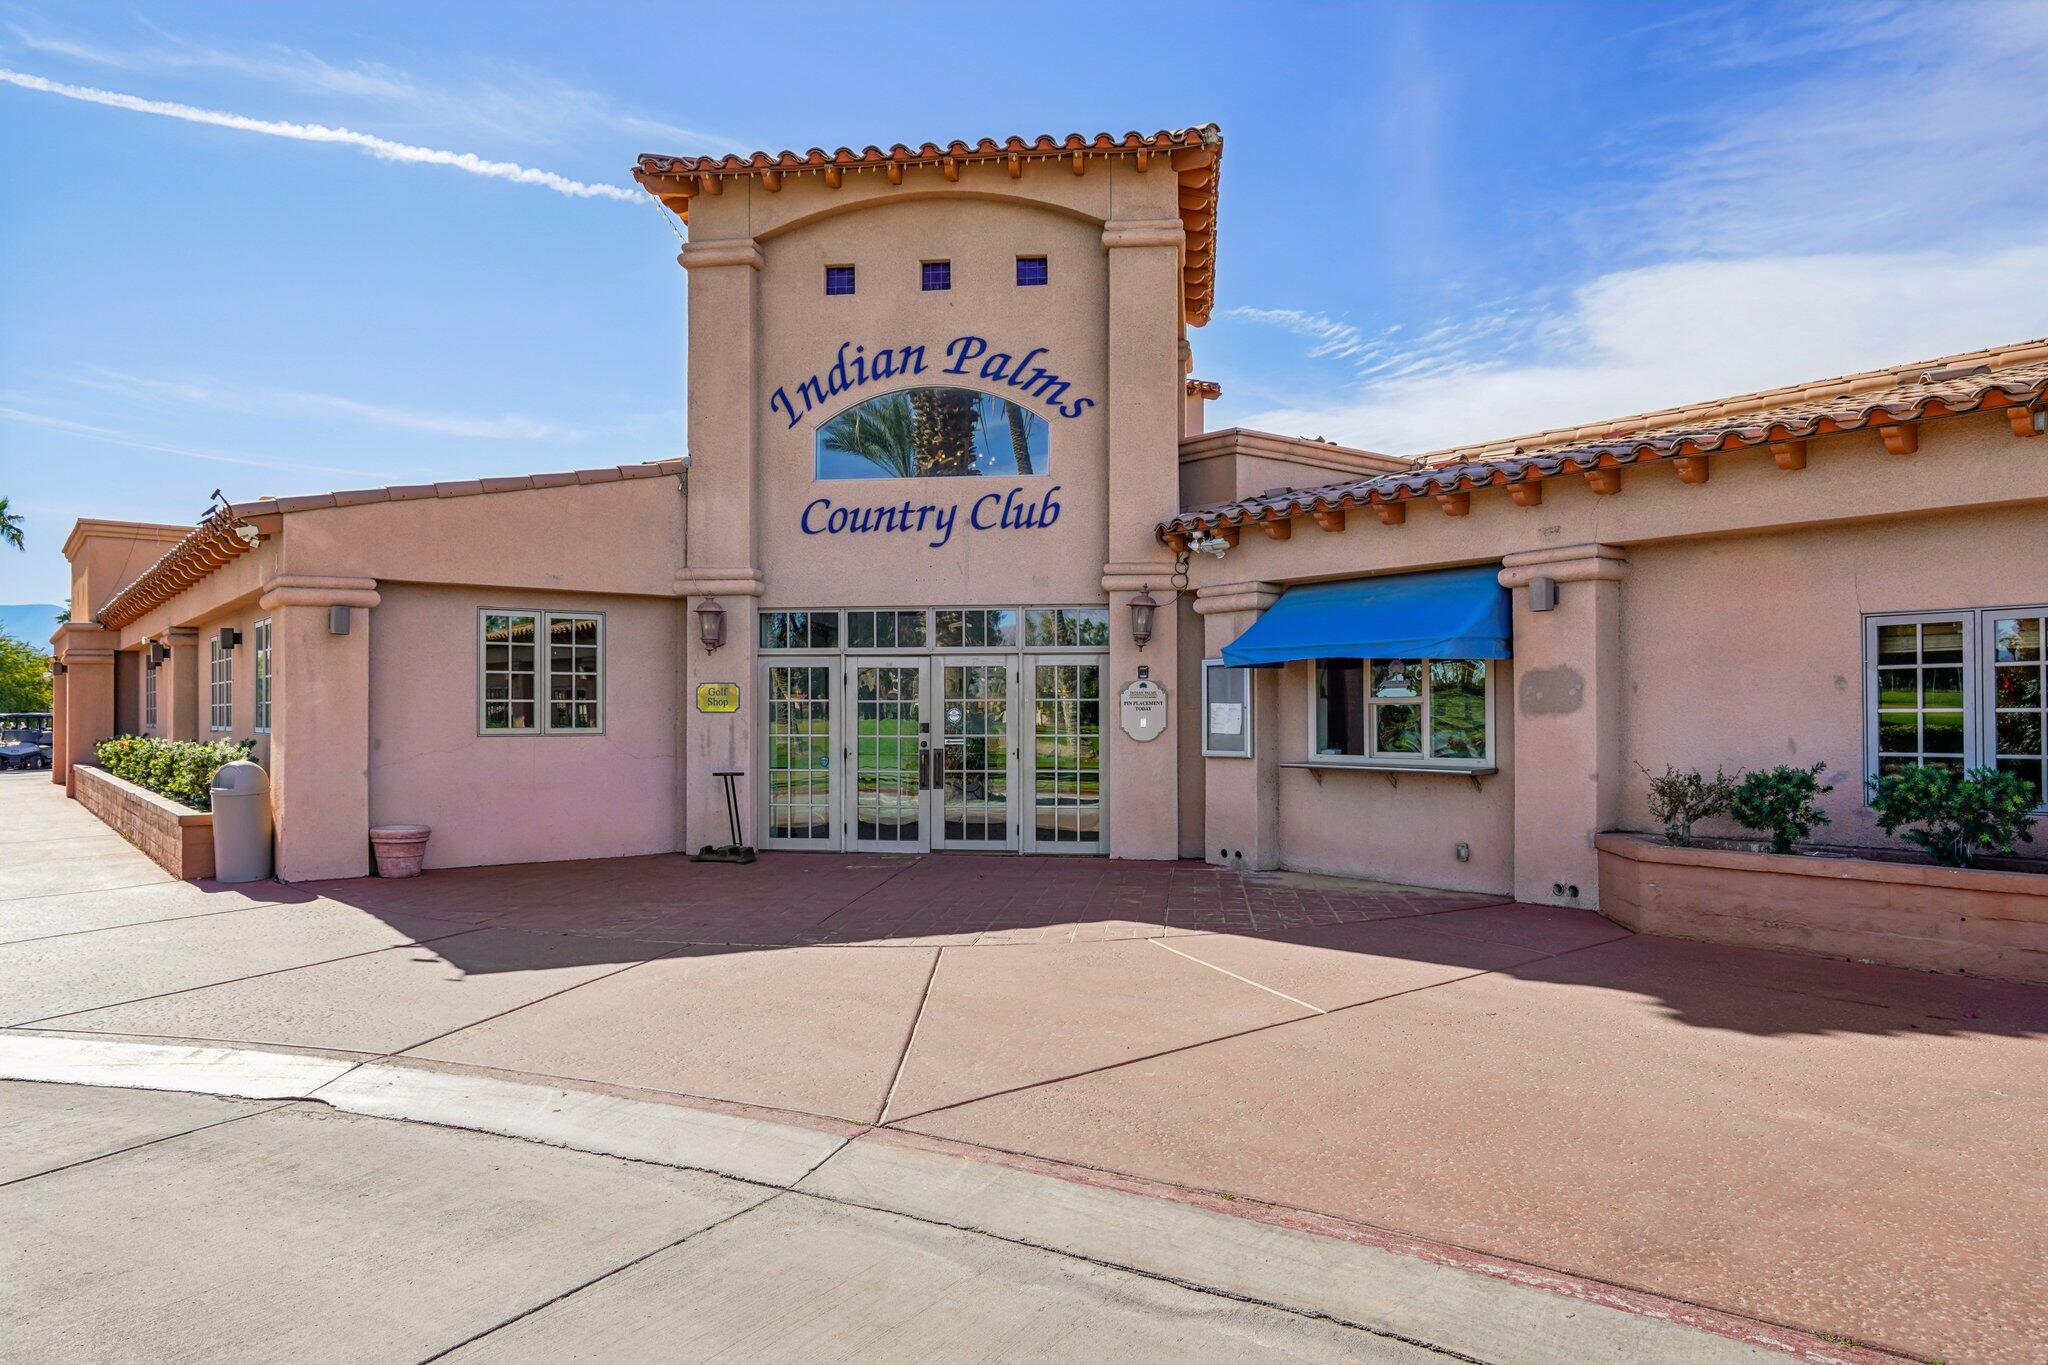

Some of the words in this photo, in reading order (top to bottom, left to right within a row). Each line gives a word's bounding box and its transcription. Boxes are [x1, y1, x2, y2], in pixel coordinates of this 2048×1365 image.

[770, 341, 928, 429] Indian
[943, 335, 1095, 421] Palms
[801, 498, 958, 549] Country
[971, 486, 1062, 531] Club
[707, 698, 729, 707] Shop
[708, 688, 728, 697] Golf
